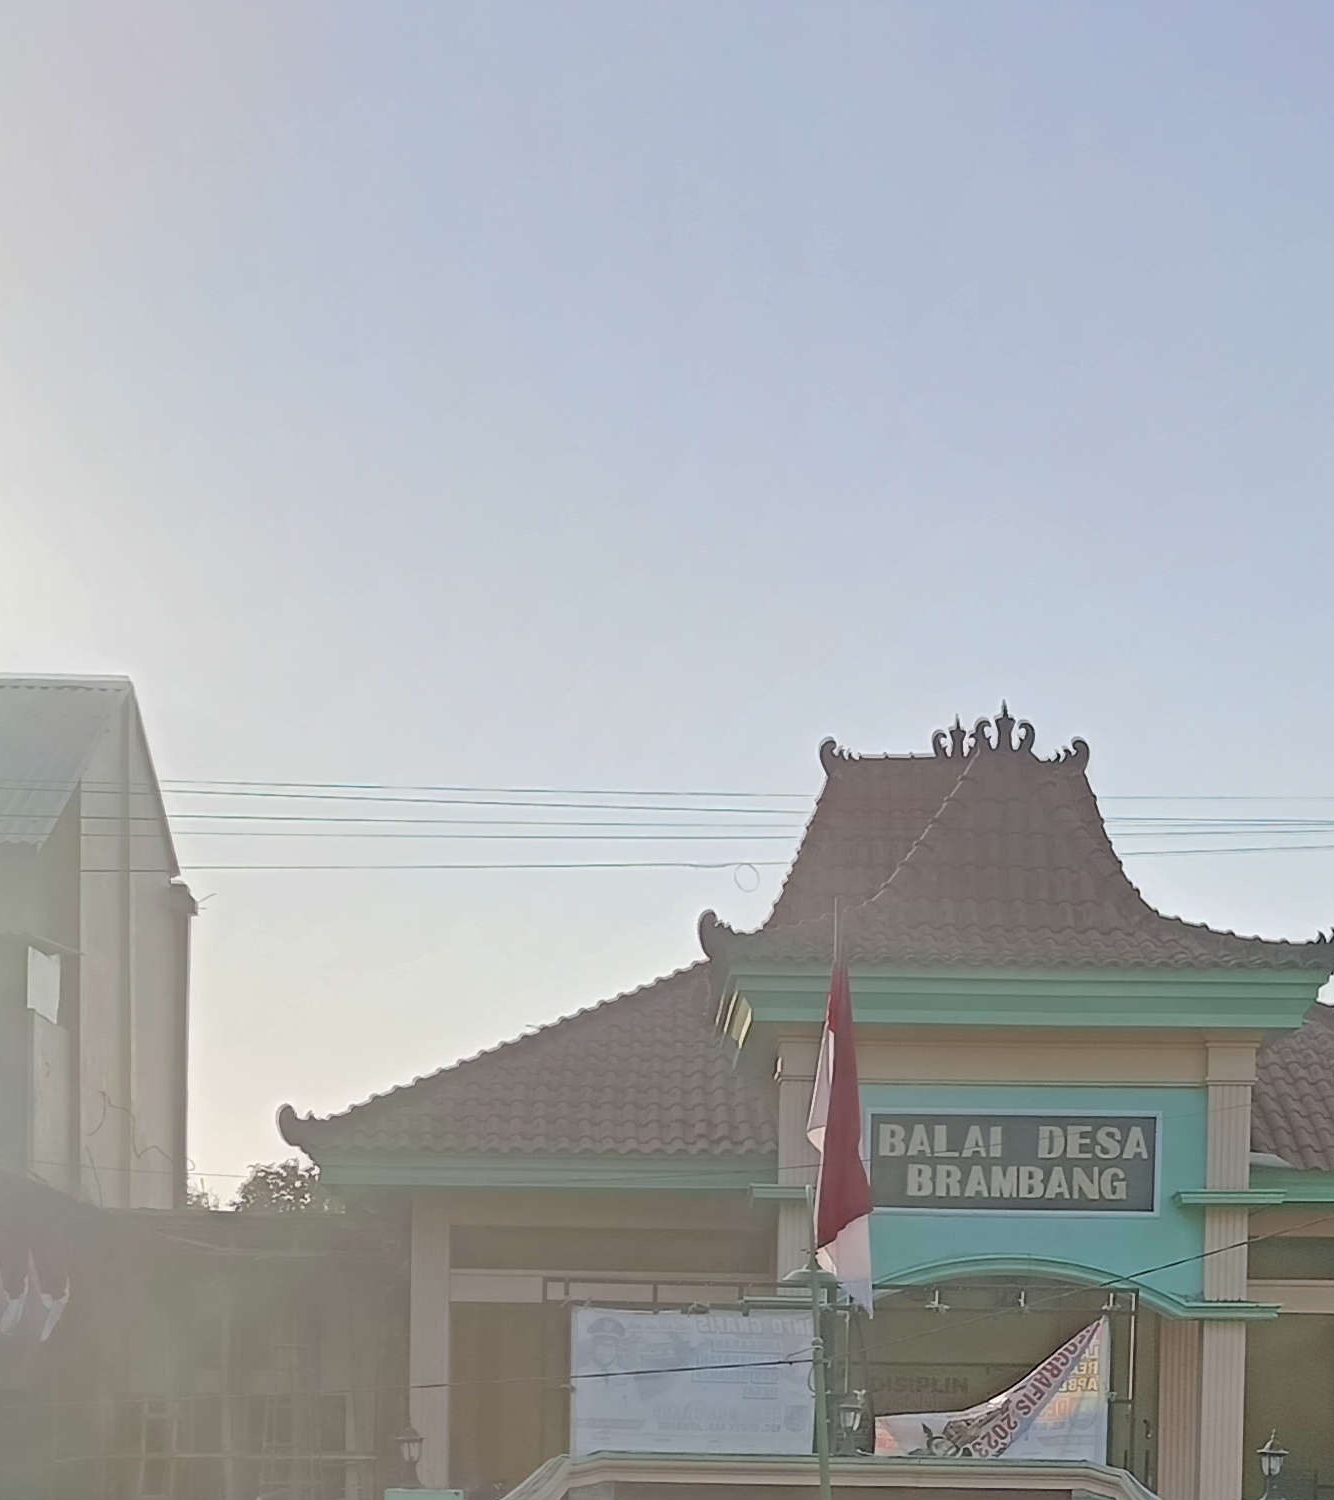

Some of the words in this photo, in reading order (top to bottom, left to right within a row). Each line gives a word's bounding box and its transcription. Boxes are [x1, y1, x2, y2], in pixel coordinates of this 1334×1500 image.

[878, 1124, 1003, 1157] BALAI
[1037, 1125, 1149, 1160] DESA
[906, 1163, 1128, 1200] BRAMBANG
